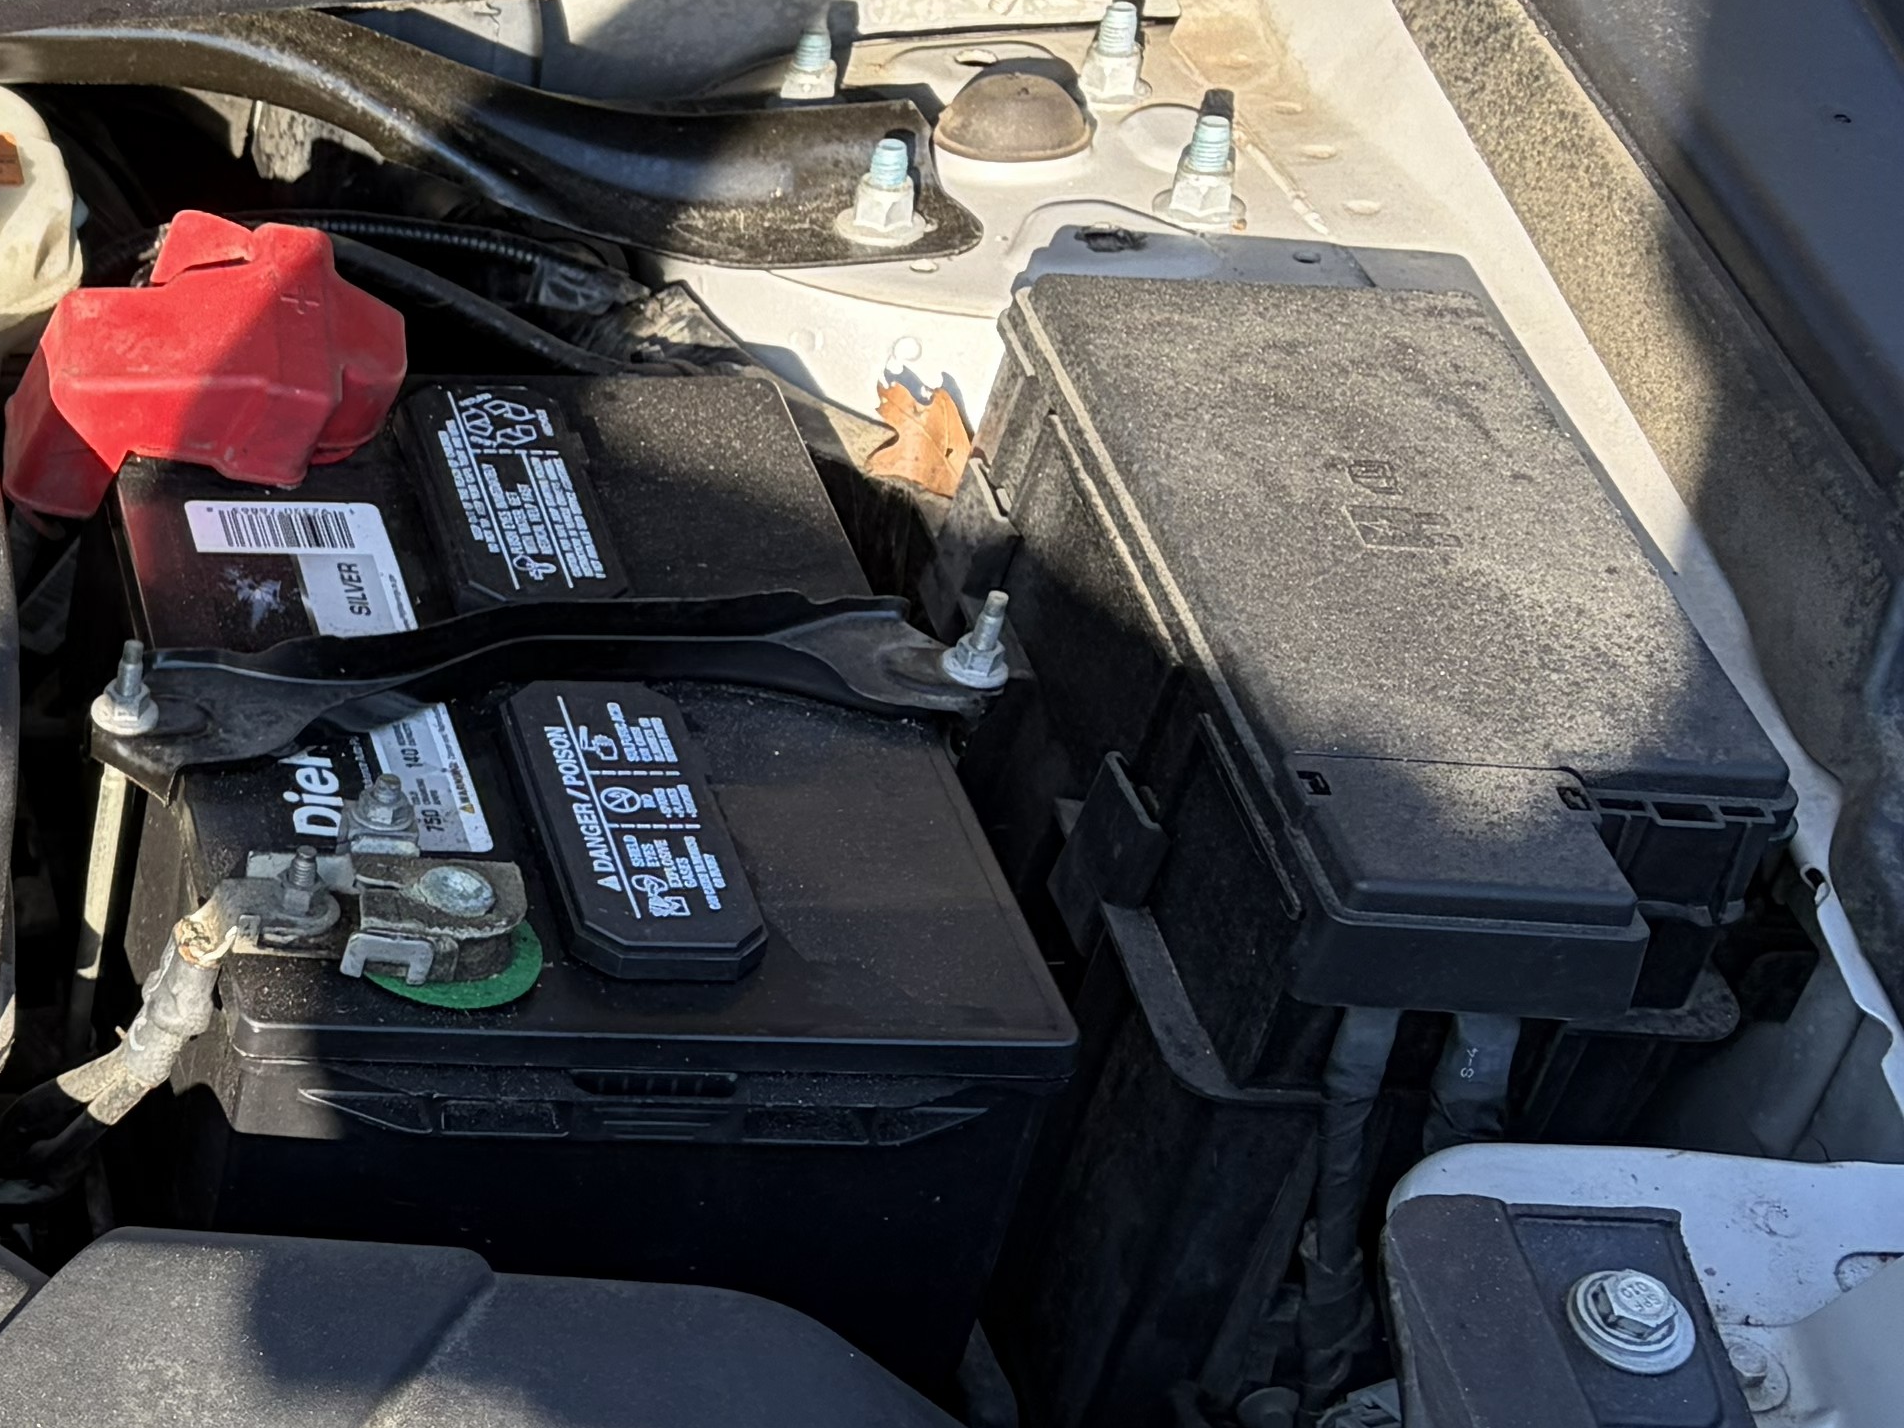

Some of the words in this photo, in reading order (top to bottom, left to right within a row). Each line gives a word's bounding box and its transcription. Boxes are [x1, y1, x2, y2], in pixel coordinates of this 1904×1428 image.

[337, 562, 372, 617] SILVER
[401, 748, 423, 768] 140
[544, 726, 585, 787] POISON
[421, 809, 444, 833] 750
[572, 802, 617, 872] DANGER
[623, 835, 645, 867] SHIELD
[641, 843, 660, 867] EYES
[653, 839, 683, 888] EXPLOSIVE
[676, 857, 697, 888] GASES
